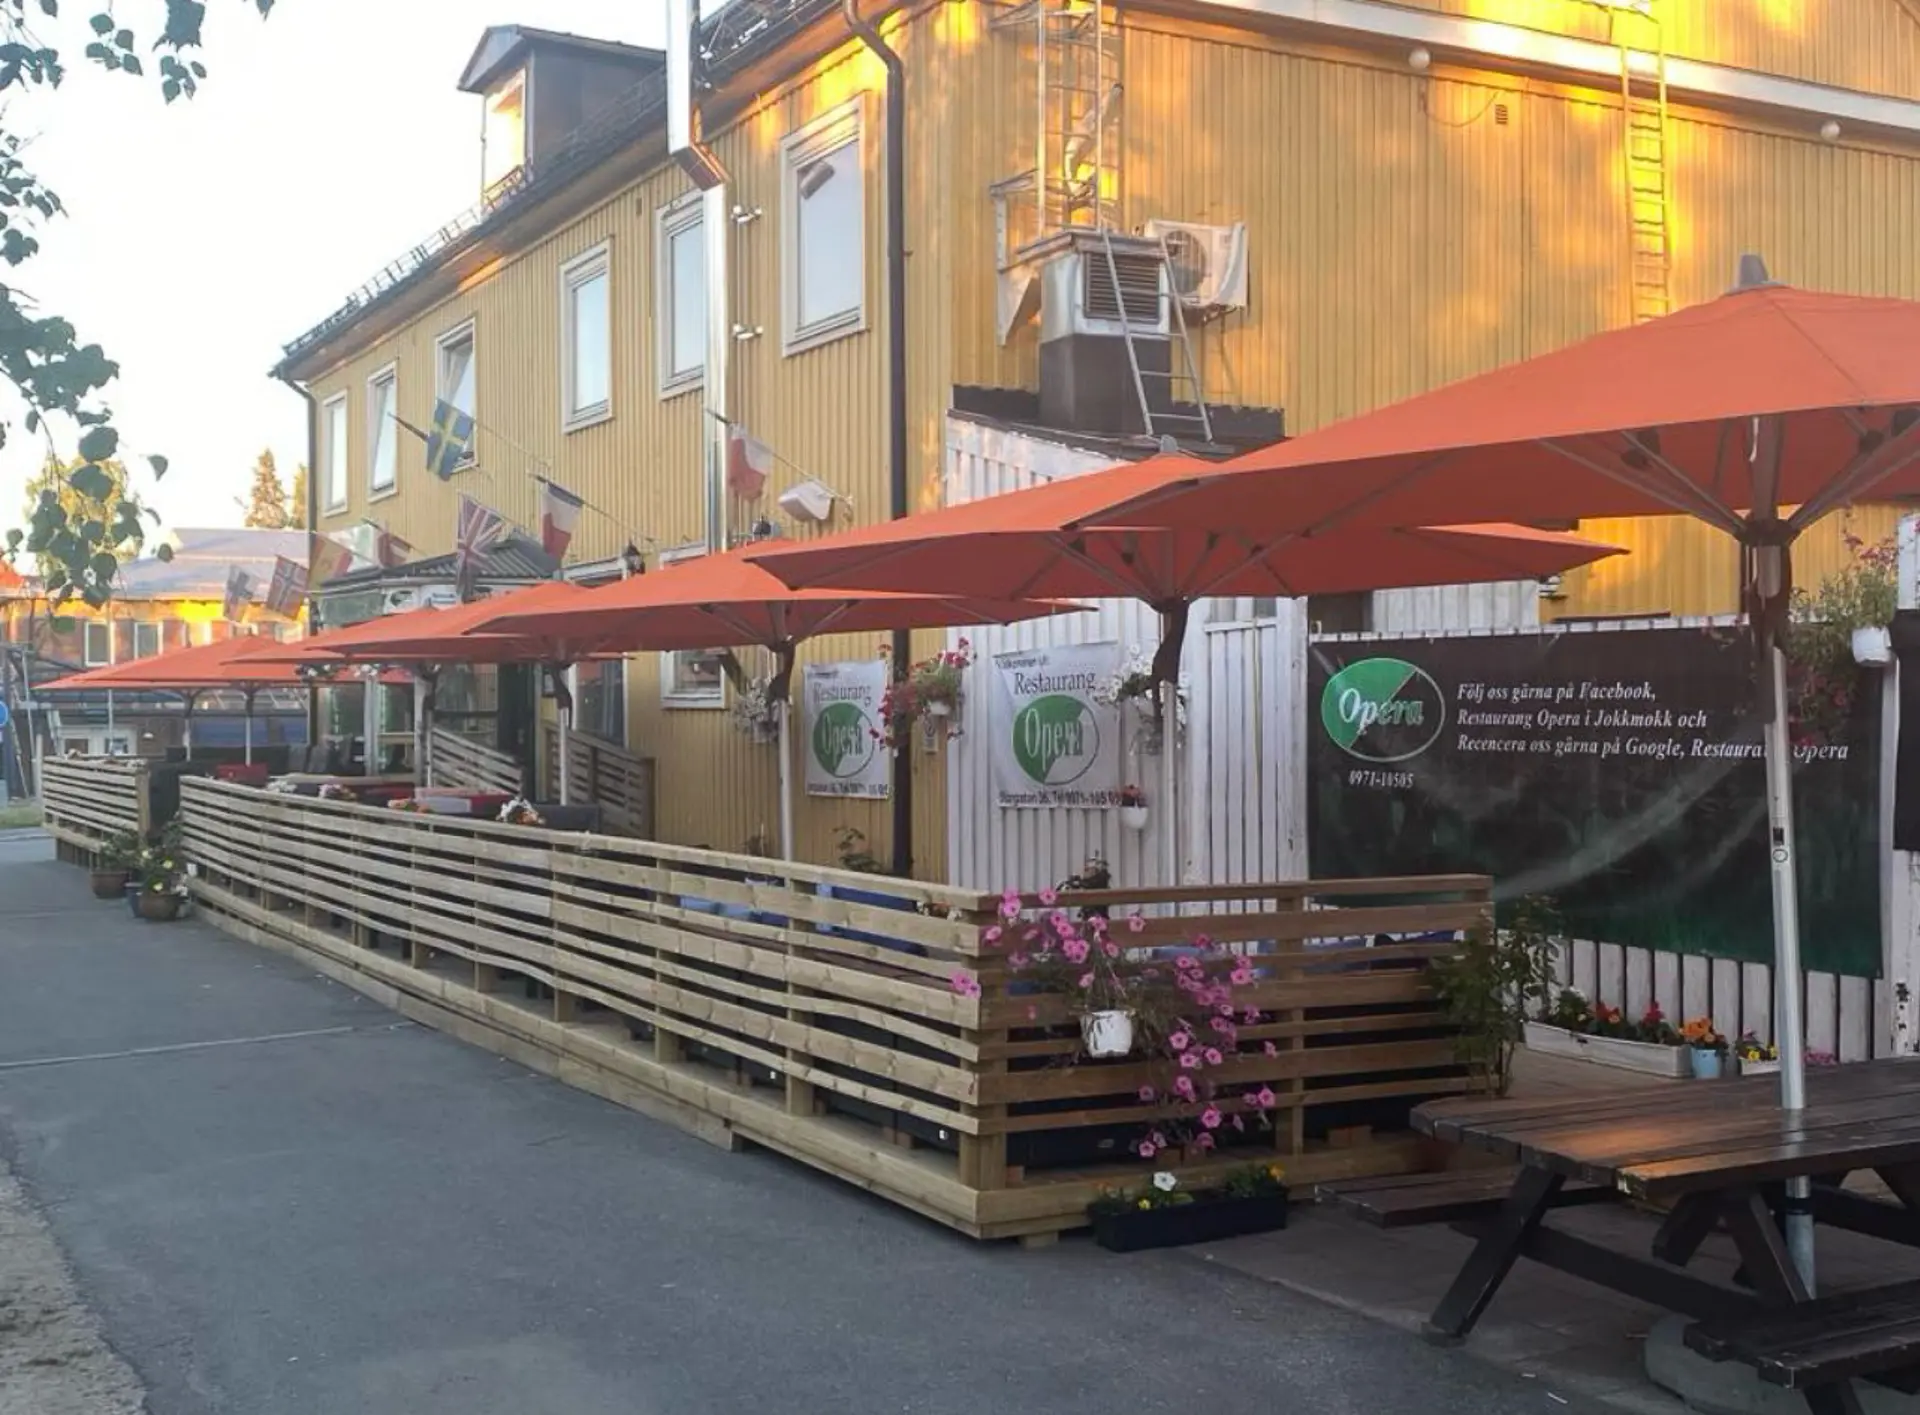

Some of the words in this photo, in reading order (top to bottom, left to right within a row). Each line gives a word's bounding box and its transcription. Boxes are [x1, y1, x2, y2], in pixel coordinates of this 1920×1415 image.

[1013, 671, 1097, 696] Restaurang
[1457, 683, 1485, 704] Följ
[1486, 687, 1509, 701] oss
[1511, 683, 1553, 704] gärna
[1555, 680, 1575, 704] på
[1578, 680, 1656, 702] Facebook,
[1338, 687, 1425, 735] Opera
[1456, 707, 1533, 730] Restaurang
[1536, 707, 1581, 731] Opera
[1583, 709, 1592, 727] i
[1593, 708, 1673, 728] Jokkmokk
[1677, 708, 1708, 729] och
[822, 712, 864, 769] Opera
[1025, 707, 1084, 773] Opera
[1529, 742, 1551, 752] oss
[1554, 735, 1598, 758] gärna
[1600, 737, 1621, 759] på
[1624, 737, 1686, 761] Google,
[1690, 737, 1769, 759] Restaura
